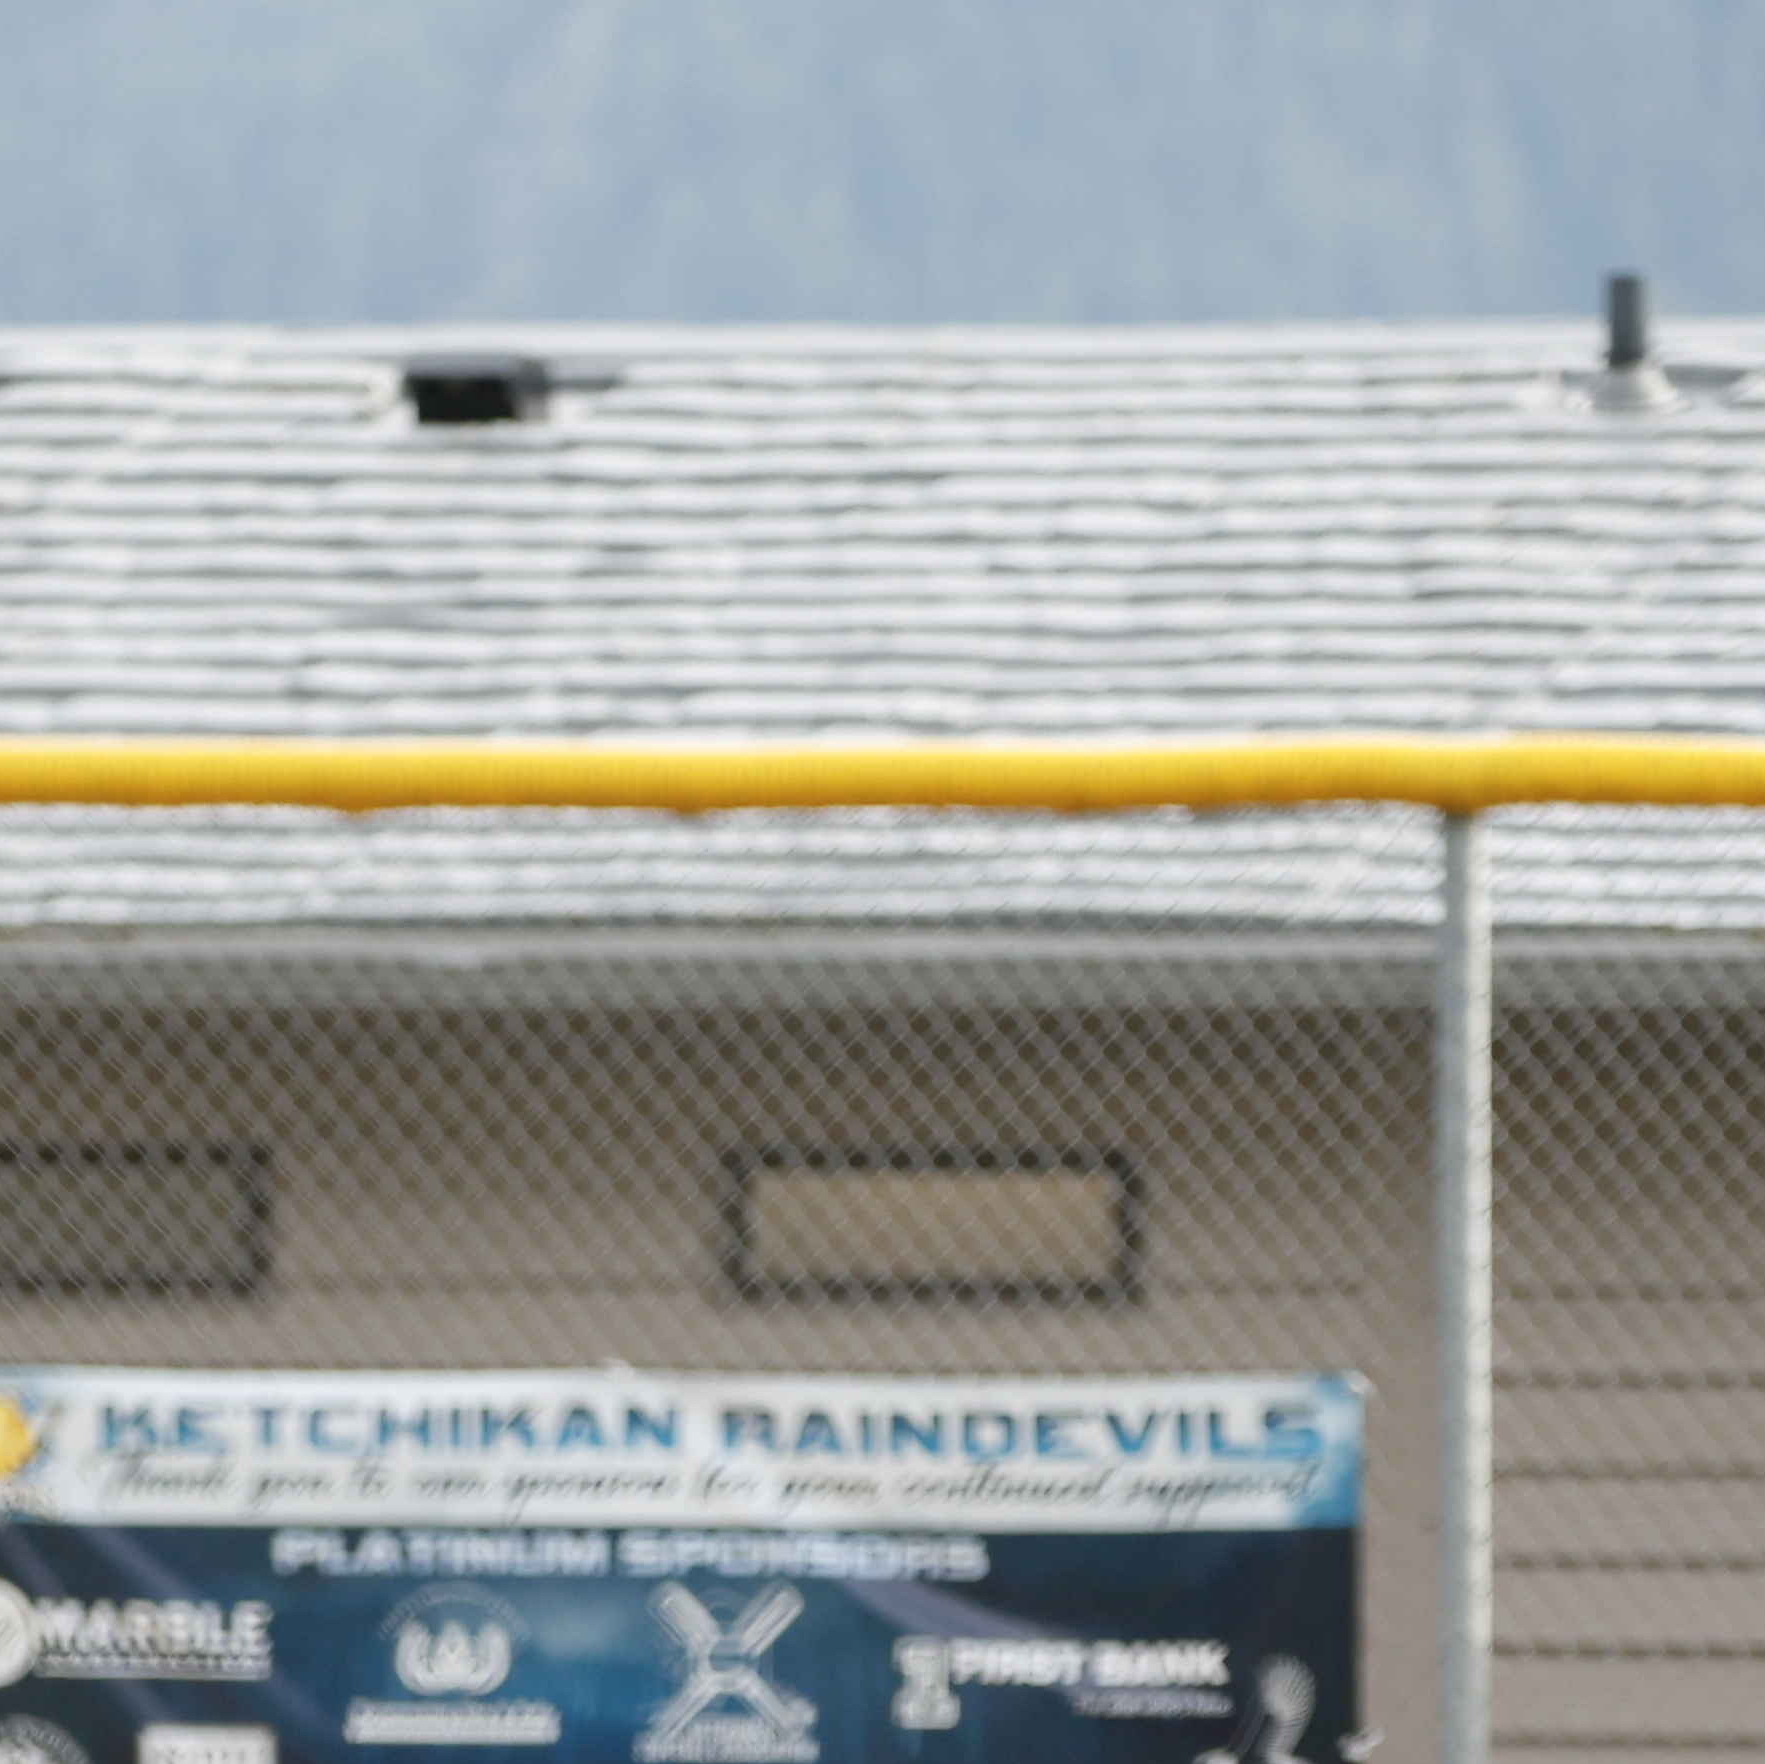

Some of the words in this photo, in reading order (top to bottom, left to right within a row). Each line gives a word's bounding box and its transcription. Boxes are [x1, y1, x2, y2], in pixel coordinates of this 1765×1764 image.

[102, 1403, 678, 1453] KETCHIKAN
[721, 1405, 1326, 1461] RAINDEVILS
[244, 1470, 338, 1516] you
[782, 1472, 884, 1520] your
[902, 1462, 1114, 1506] continued
[1122, 1460, 1326, 1528] support
[270, 1528, 610, 1577] PLATINUM
[616, 1530, 992, 1581] SPONSORS
[37, 1596, 274, 1656] MARBLE
[949, 1638, 1086, 1687] FIRST
[1090, 1638, 1231, 1688] BANK
